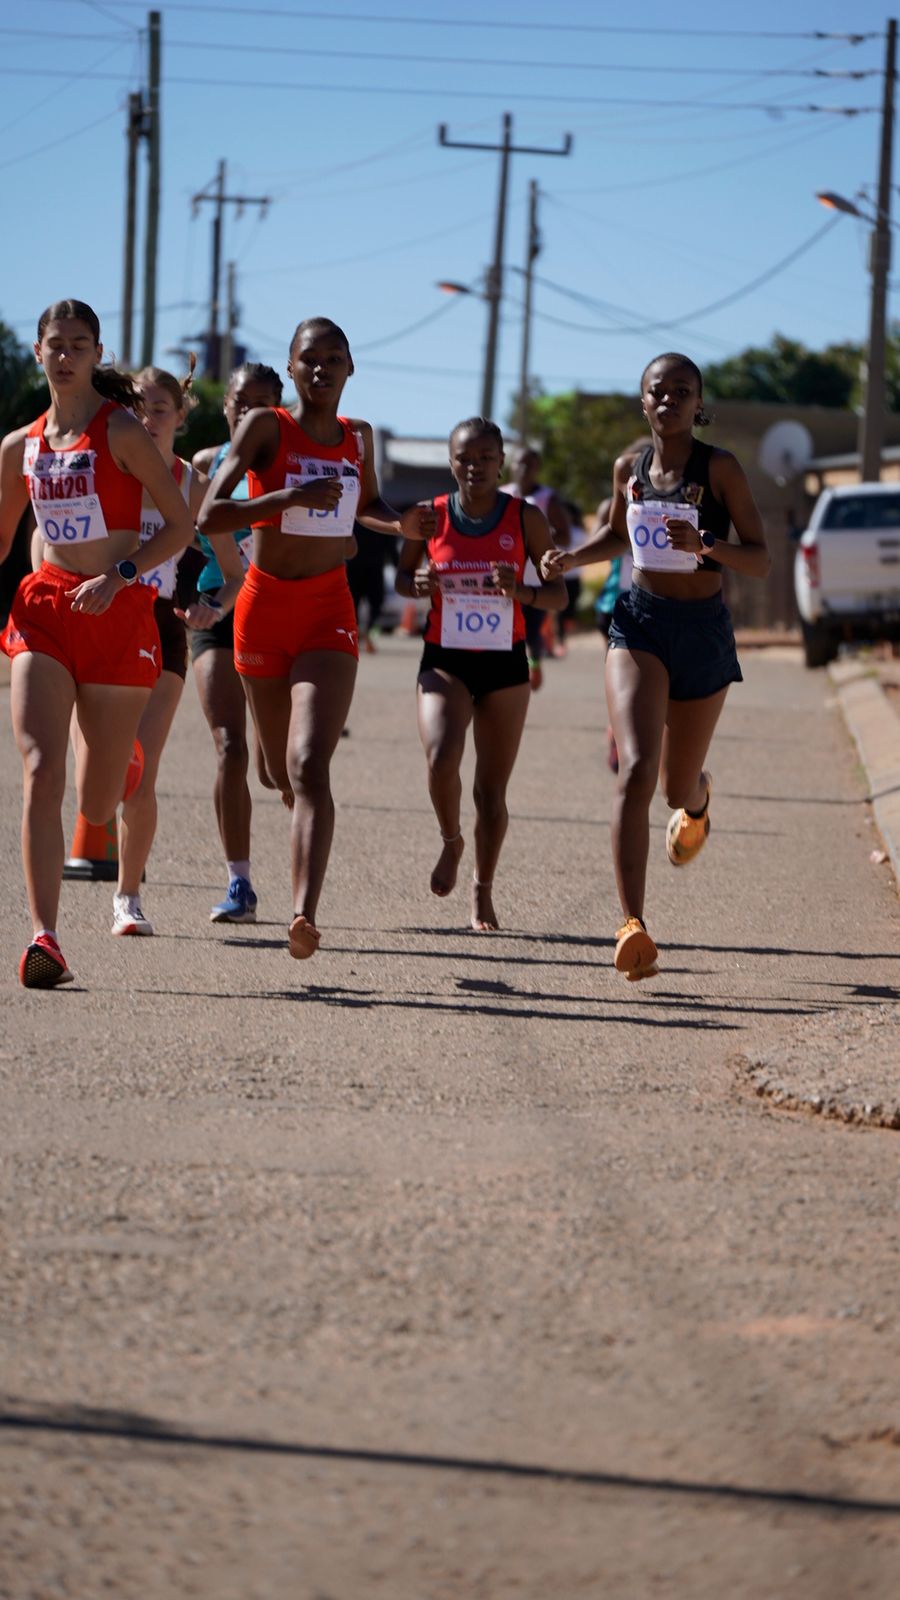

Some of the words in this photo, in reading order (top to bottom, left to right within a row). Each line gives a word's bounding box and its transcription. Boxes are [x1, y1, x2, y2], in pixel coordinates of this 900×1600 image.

[44, 515, 91, 541] 067
[633, 524, 669, 550] 00
[455, 611, 501, 633] 109
